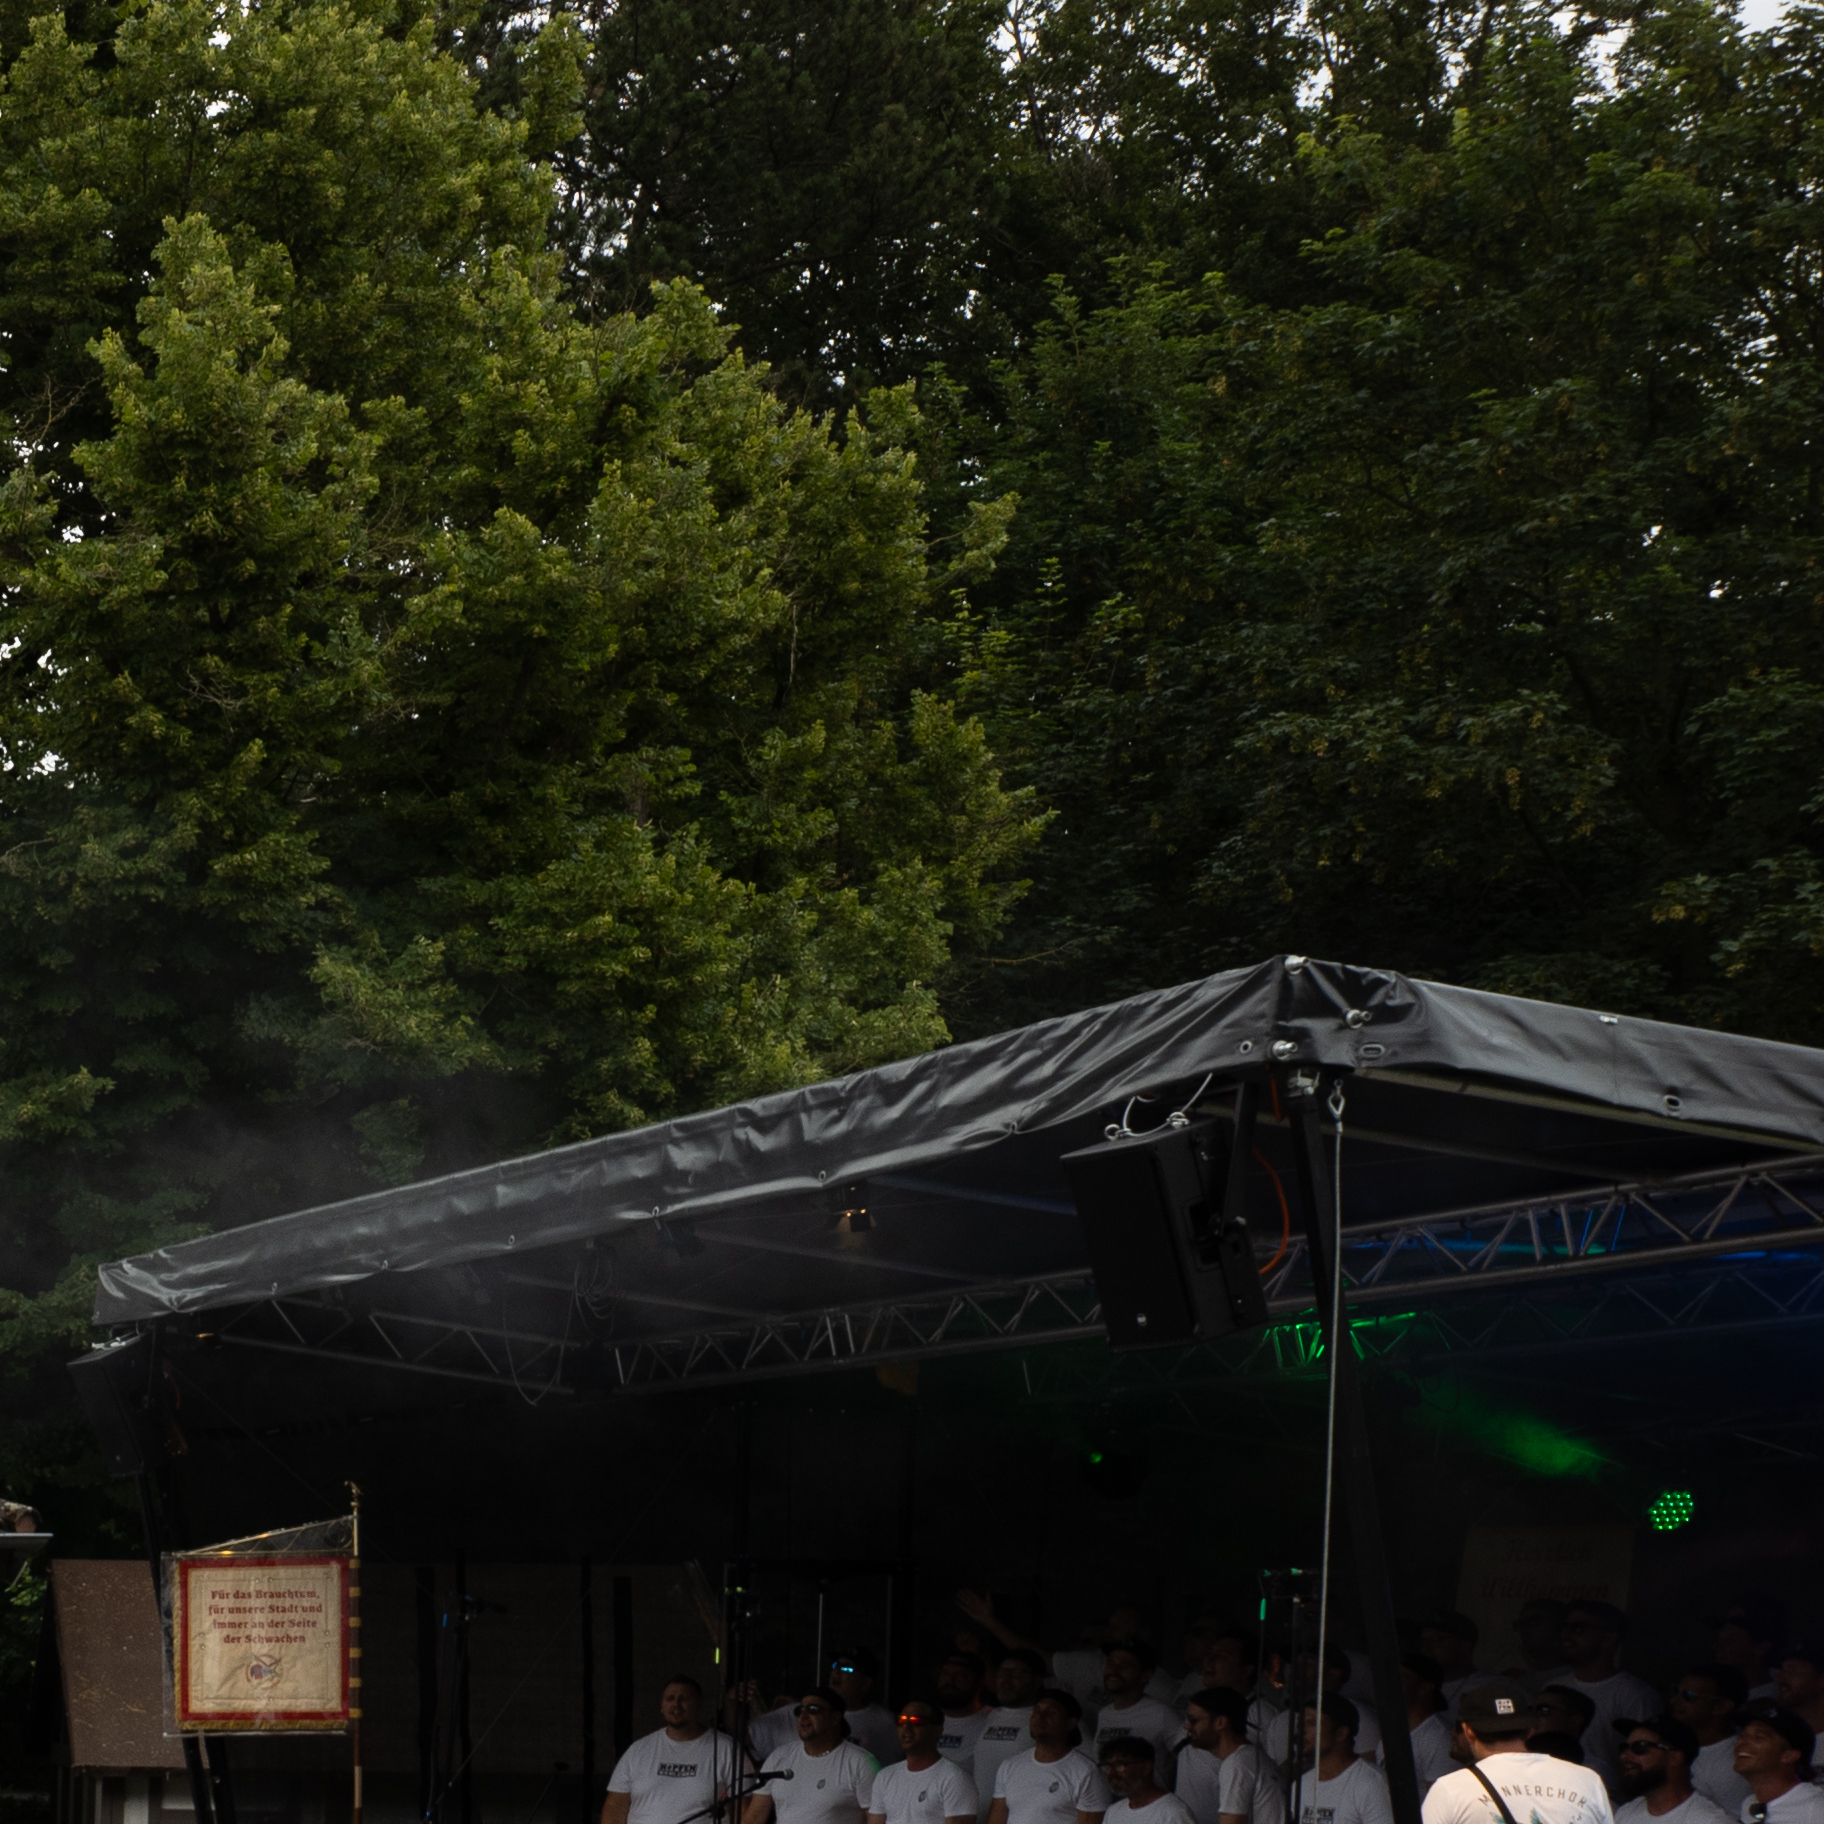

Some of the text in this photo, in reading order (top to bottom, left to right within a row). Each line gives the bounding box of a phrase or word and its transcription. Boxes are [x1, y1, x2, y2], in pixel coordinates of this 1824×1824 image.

[211, 1588, 320, 1600] Für das Brauchtum,
[208, 1604, 323, 1616] für unsere Stadt und
[251, 1621, 265, 1630] an
[267, 1619, 286, 1629] der
[288, 1618, 318, 1629] Seite
[223, 1633, 306, 1645] der Schwachen
[1478, 1784, 1588, 1807] MNNERCHOR
